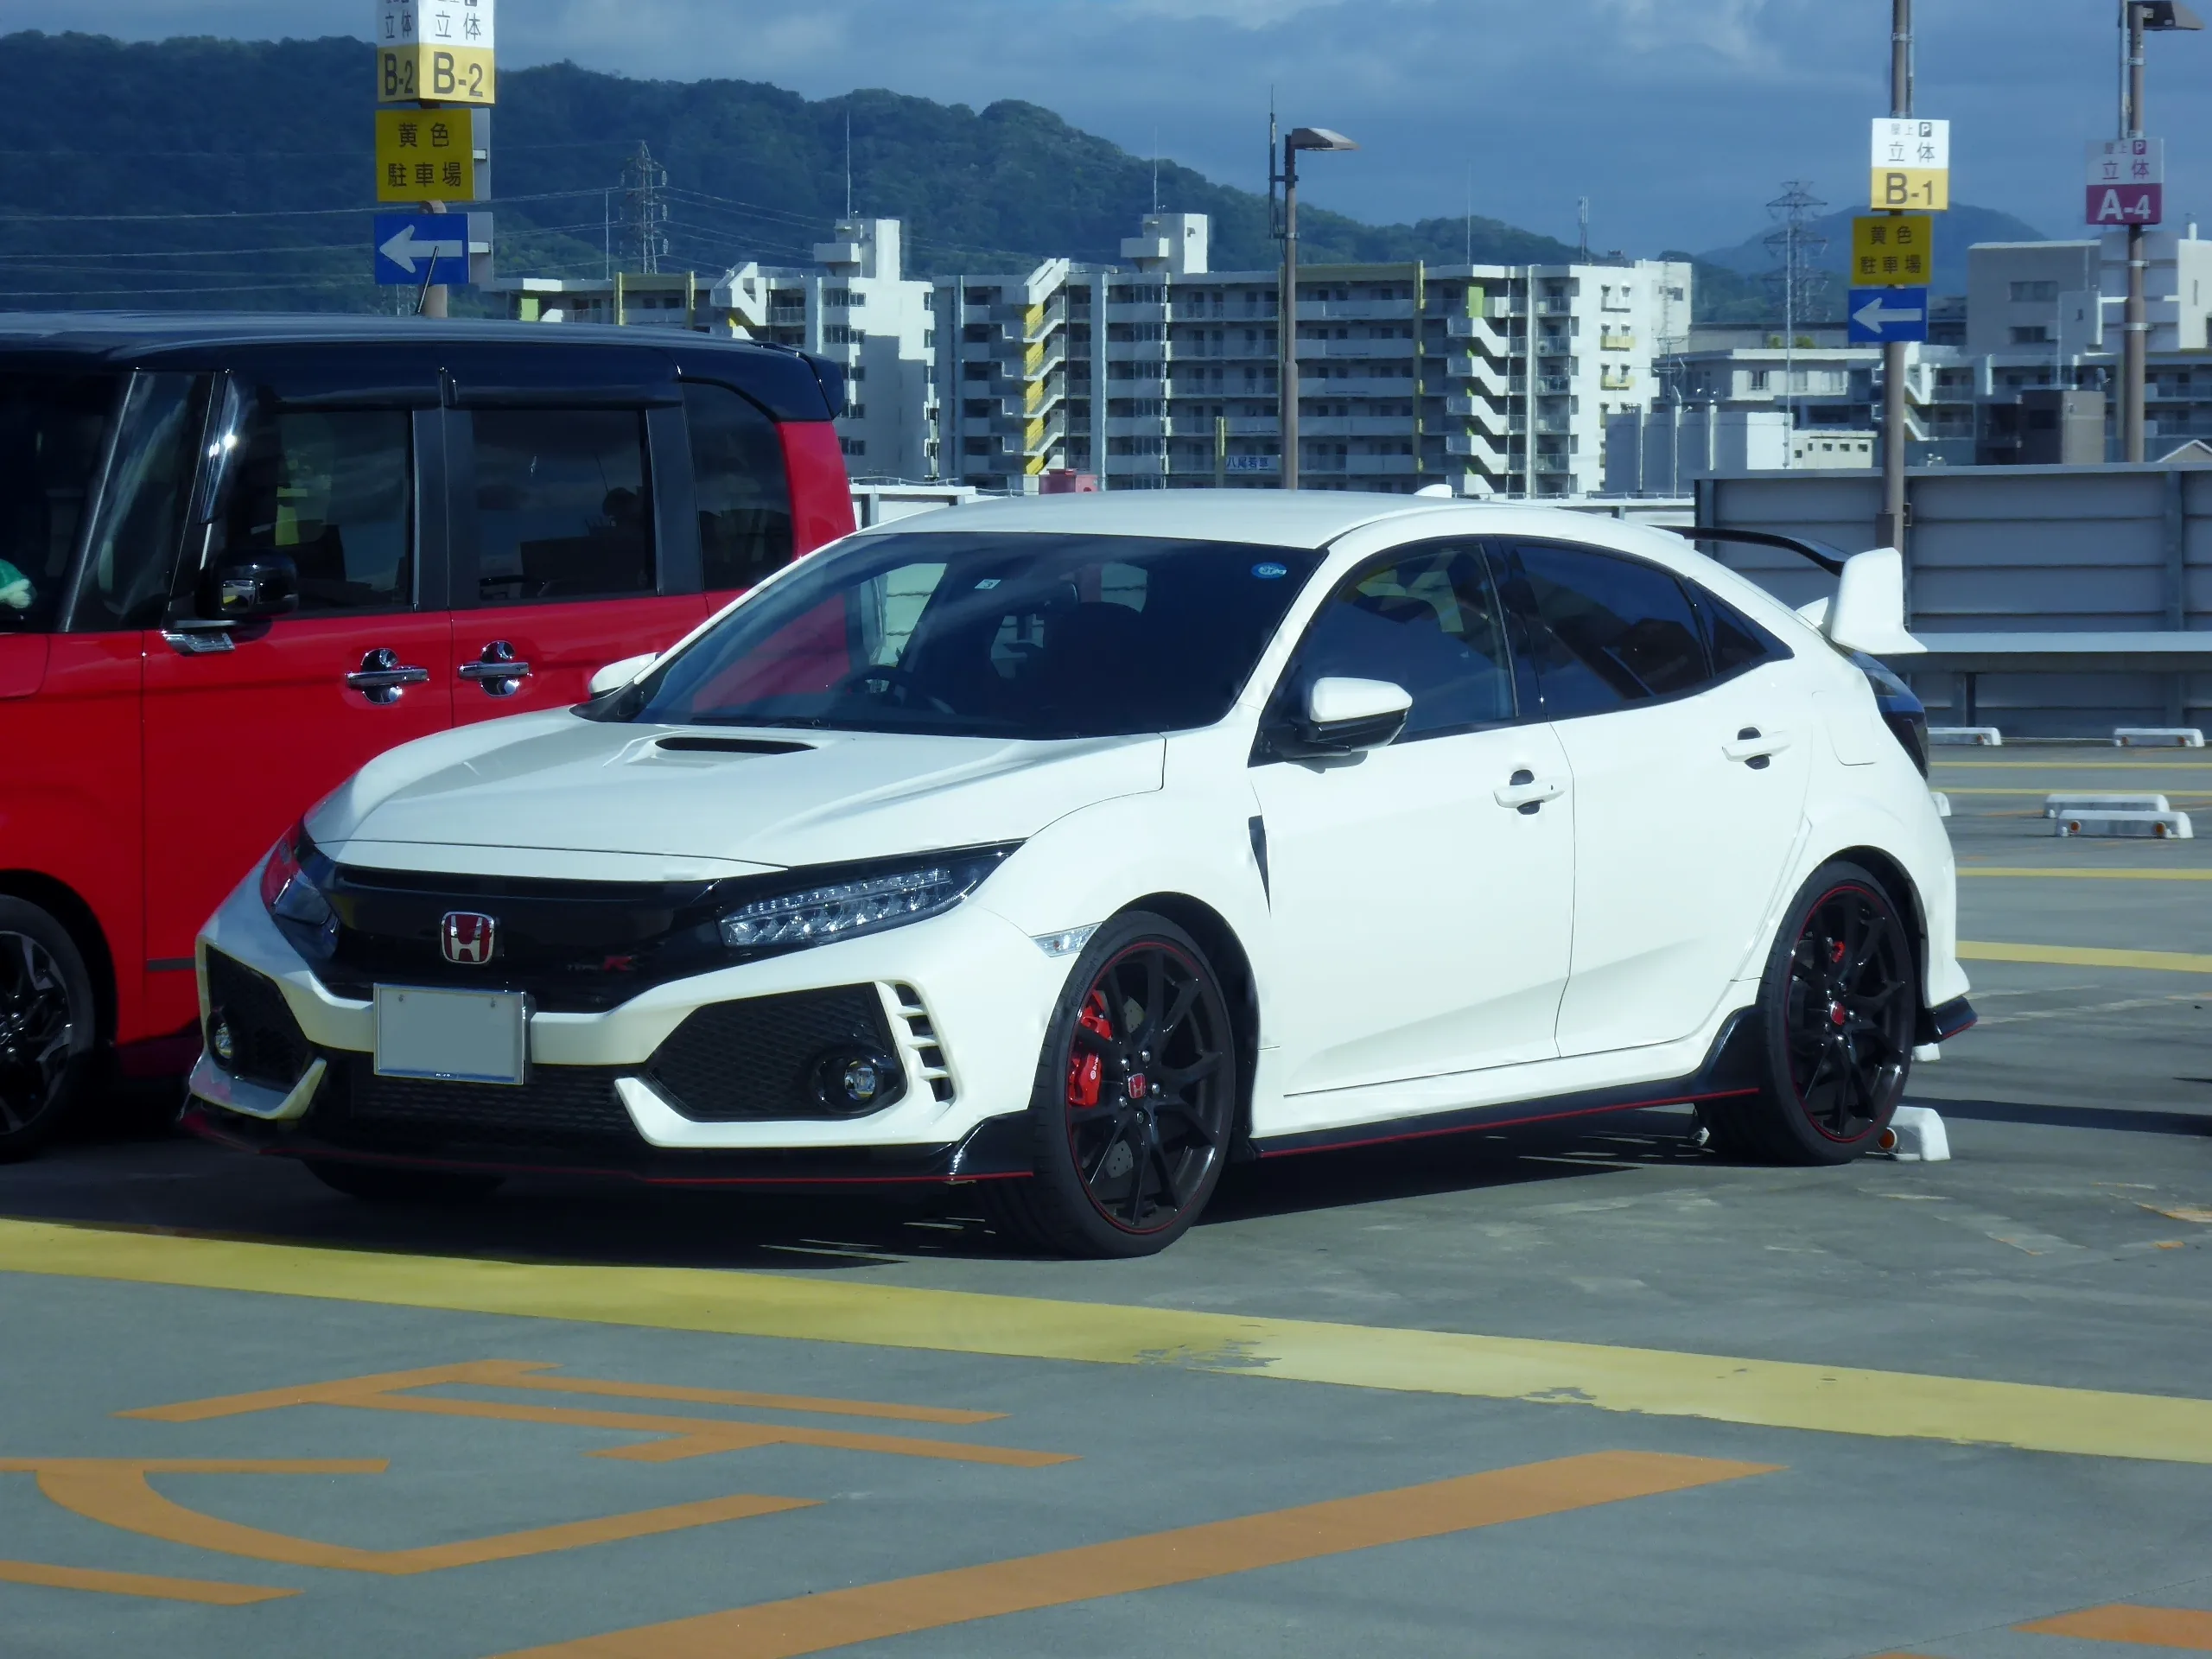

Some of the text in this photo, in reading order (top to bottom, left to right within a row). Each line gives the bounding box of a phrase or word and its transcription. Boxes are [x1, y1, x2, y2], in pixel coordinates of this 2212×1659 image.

[385, 10, 412, 39] 立体
[435, 10, 482, 41] 立体
[385, 53, 414, 96] B-2
[434, 51, 483, 97] B-2
[398, 123, 449, 148] 黄色
[1888, 141, 1935, 162] 立体
[388, 162, 461, 188] 駐車場
[2102, 158, 2150, 180] 立体
[1885, 172, 1933, 206] B-1
[2096, 188, 2152, 221] A-4
[1871, 226, 1912, 245] 黄色
[1860, 254, 1922, 275] 駐車場
